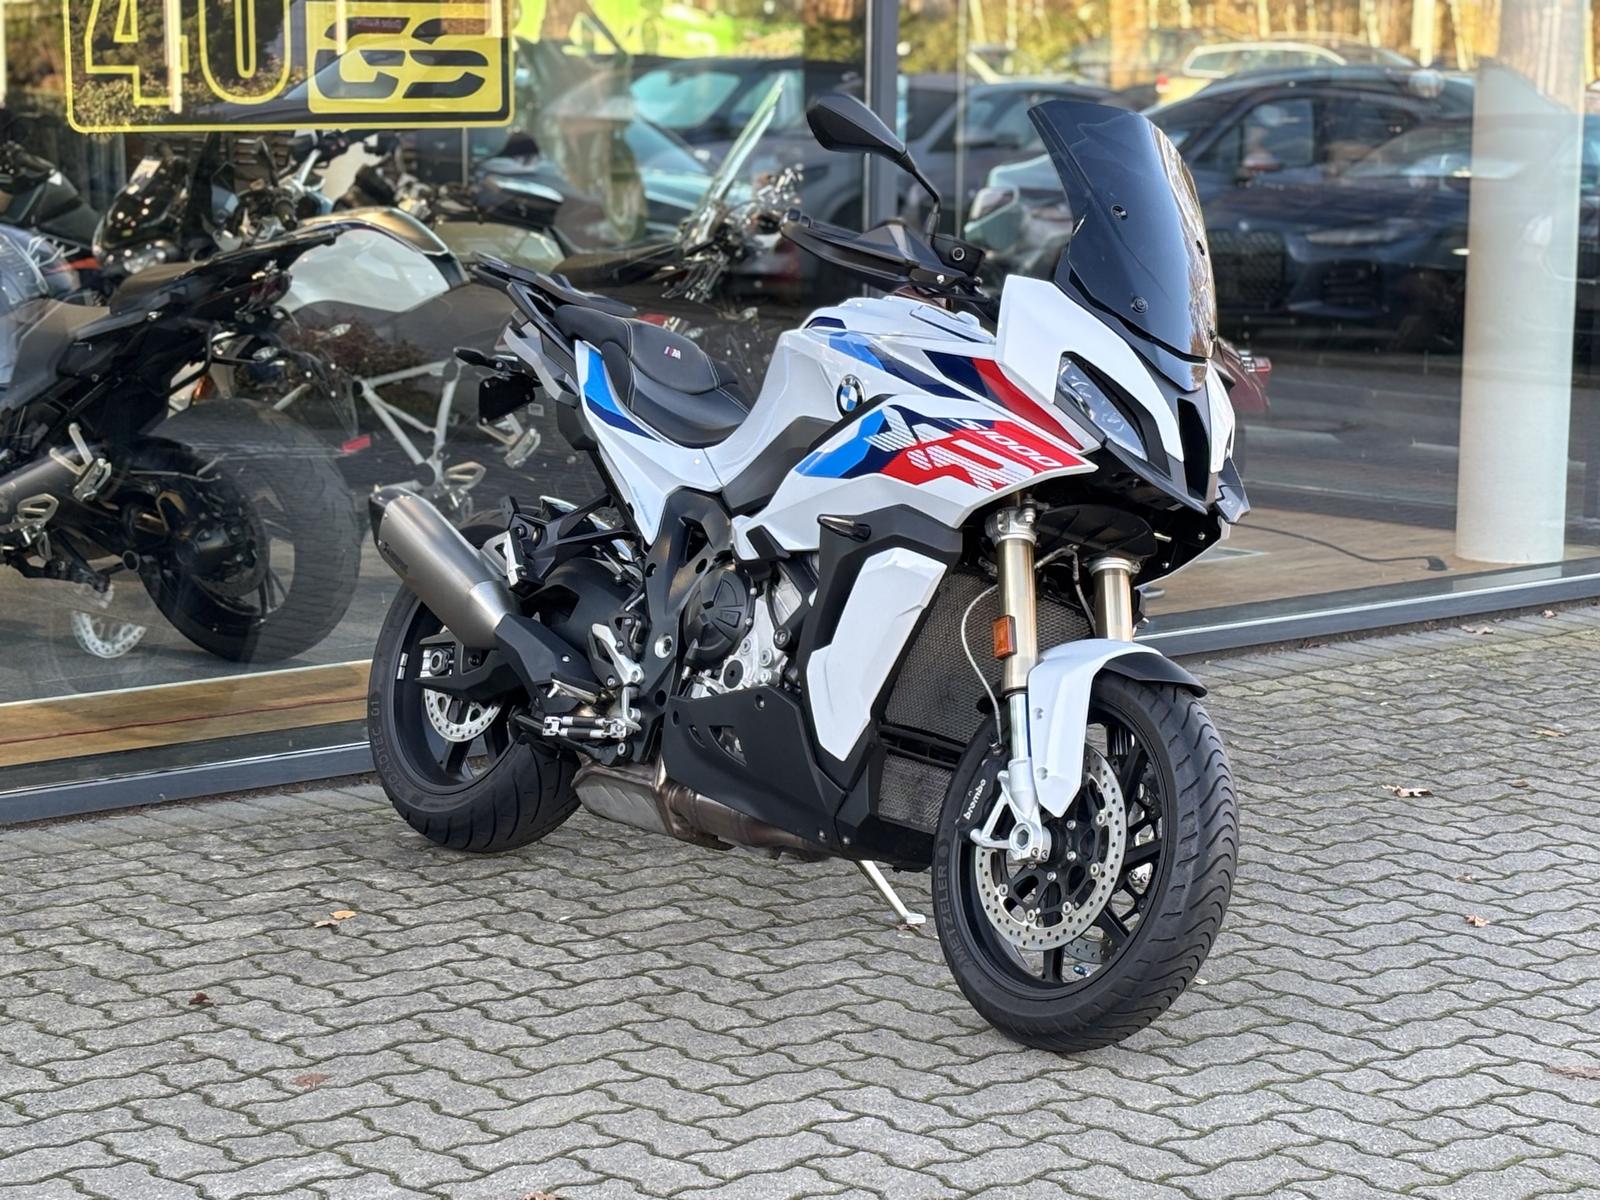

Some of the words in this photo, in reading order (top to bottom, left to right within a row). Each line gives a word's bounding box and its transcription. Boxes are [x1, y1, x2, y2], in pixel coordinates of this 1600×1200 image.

[315, 16, 489, 99] GS
[963, 778, 986, 820] brembo
[937, 864, 968, 965] METZELER
